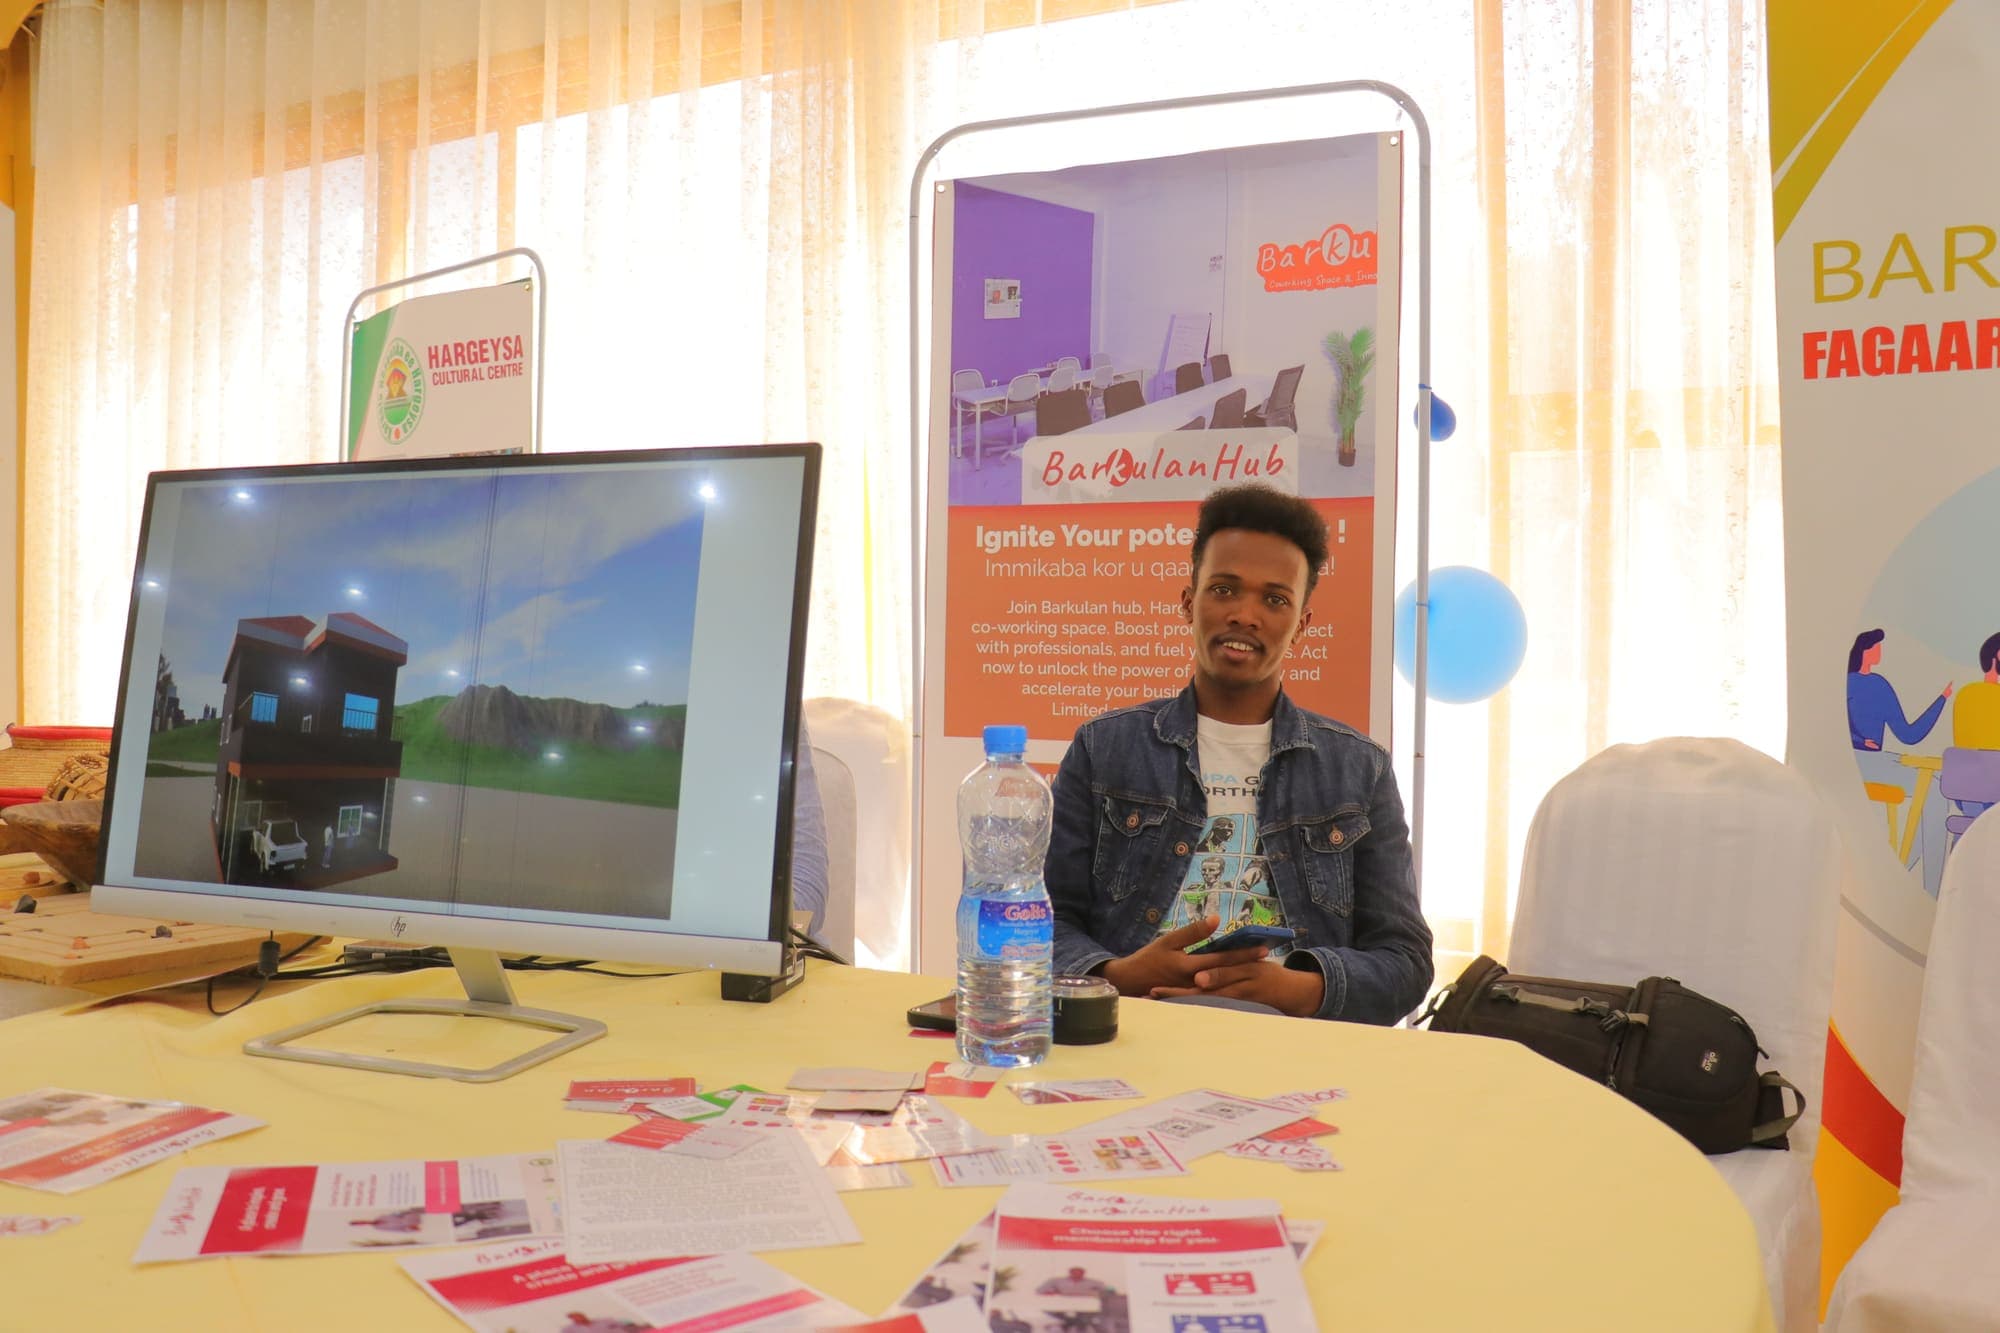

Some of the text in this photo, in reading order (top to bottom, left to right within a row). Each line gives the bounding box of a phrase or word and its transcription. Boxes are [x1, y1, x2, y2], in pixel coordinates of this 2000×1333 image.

[1813, 225, 2000, 304] BAR
[428, 335, 524, 369] HARGEYSA
[432, 362, 524, 386] CULTURAL CENTRE
[976, 524, 1055, 554] Ignite
[1061, 524, 1122, 547] Your
[986, 558, 1087, 577] Immikaba
[1093, 558, 1126, 577] kor
[1131, 563, 1144, 577] u
[1007, 600, 1037, 615] Join
[1041, 600, 1108, 615] Barkulan
[1112, 601, 1145, 617] hub,
[972, 621, 1057, 637] co-working
[1061, 623, 1110, 638] space.
[1115, 621, 1159, 636] Boost
[976, 640, 1009, 654] with
[1013, 640, 1117, 657] professionals,
[1121, 642, 1150, 656] and
[1154, 642, 1185, 657] fuel
[1300, 645, 1328, 660] Act
[982, 662, 1015, 675] now
[1019, 661, 1034, 675] to
[1038, 661, 1088, 676] unlock
[1093, 662, 1118, 677] the
[1121, 664, 1171, 680] power
[1174, 663, 1191, 678] of
[1289, 666, 1321, 681] and
[1022, 682, 1101, 698] accelerate
[1105, 685, 1139, 700] your
